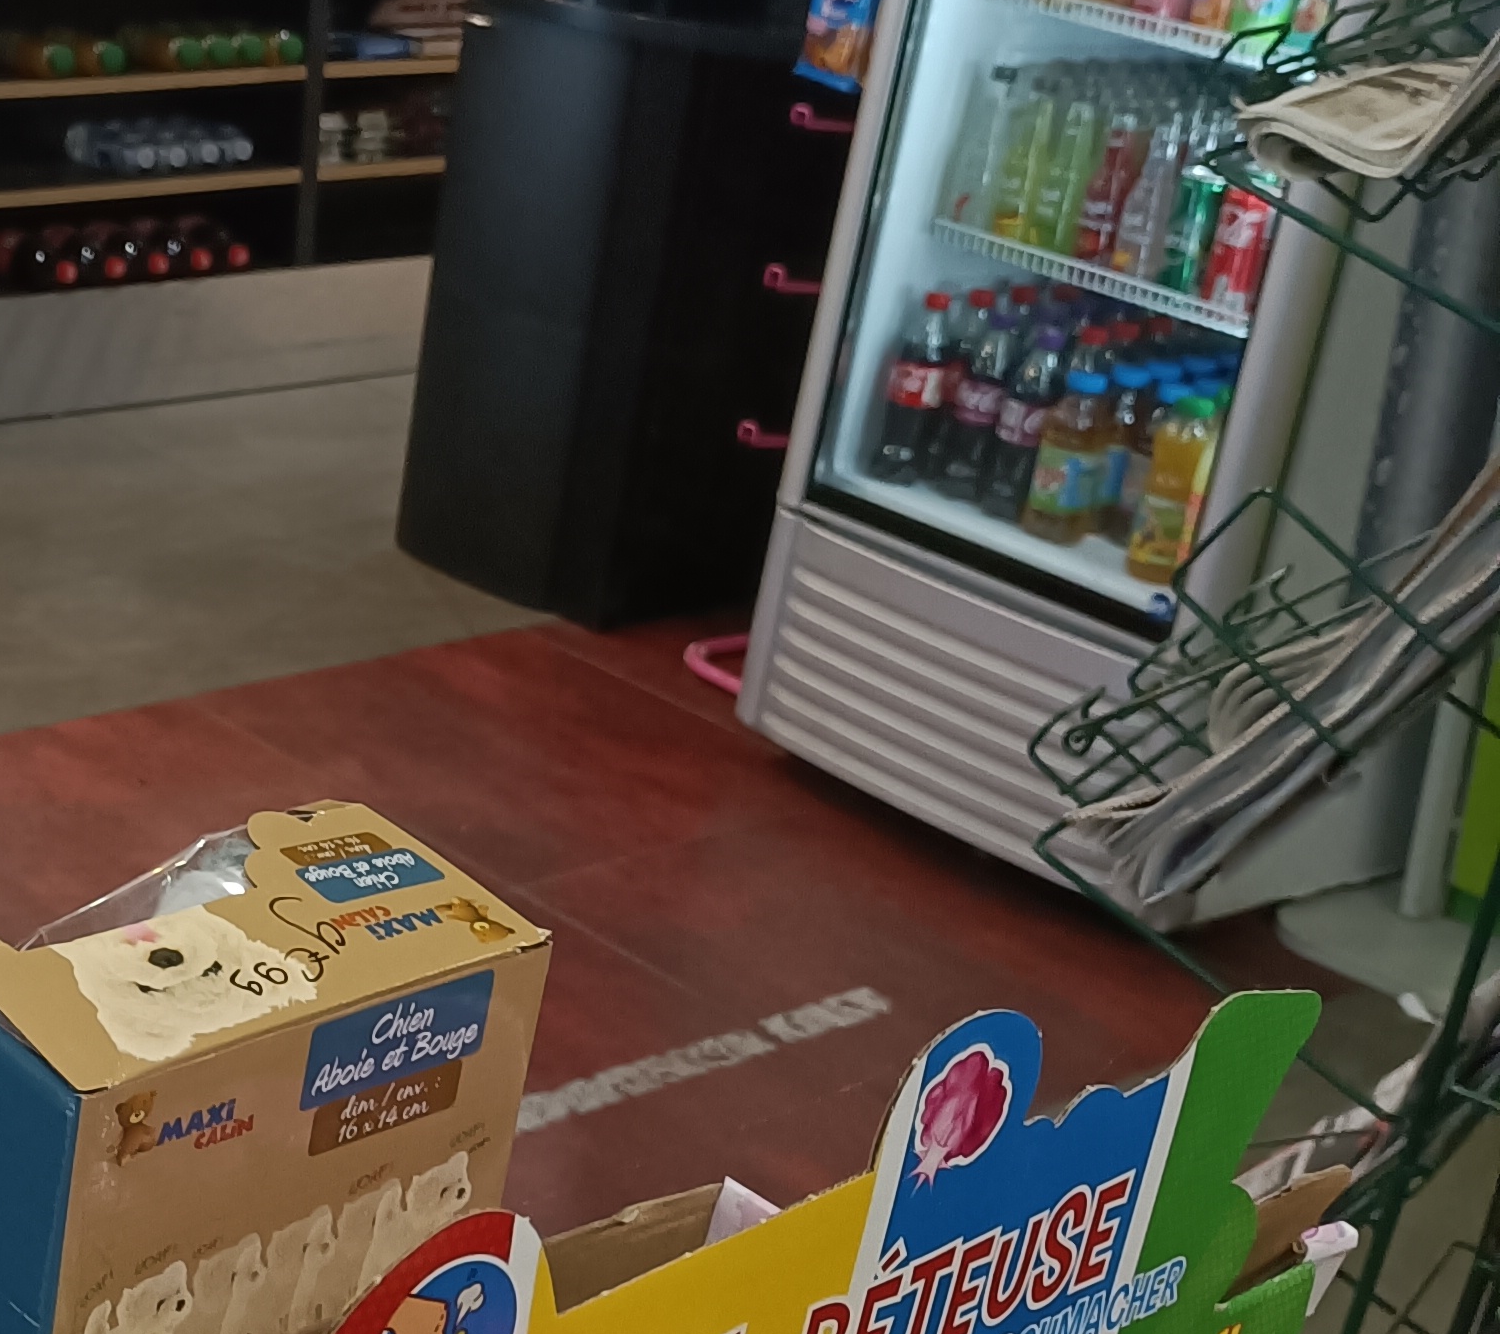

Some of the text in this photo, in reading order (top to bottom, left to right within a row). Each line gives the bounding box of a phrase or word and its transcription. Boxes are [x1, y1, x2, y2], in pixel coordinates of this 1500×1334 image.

[364, 907, 444, 941] MAXI
[371, 1002, 435, 1045] Chien
[311, 1023, 479, 1097] Aboie et Bouge
[156, 1097, 237, 1147] MAXI
[193, 1114, 255, 1150] CALIN
[338, 1119, 358, 1143] 16
[378, 1105, 399, 1129] 14
[402, 1100, 430, 1121] cm
